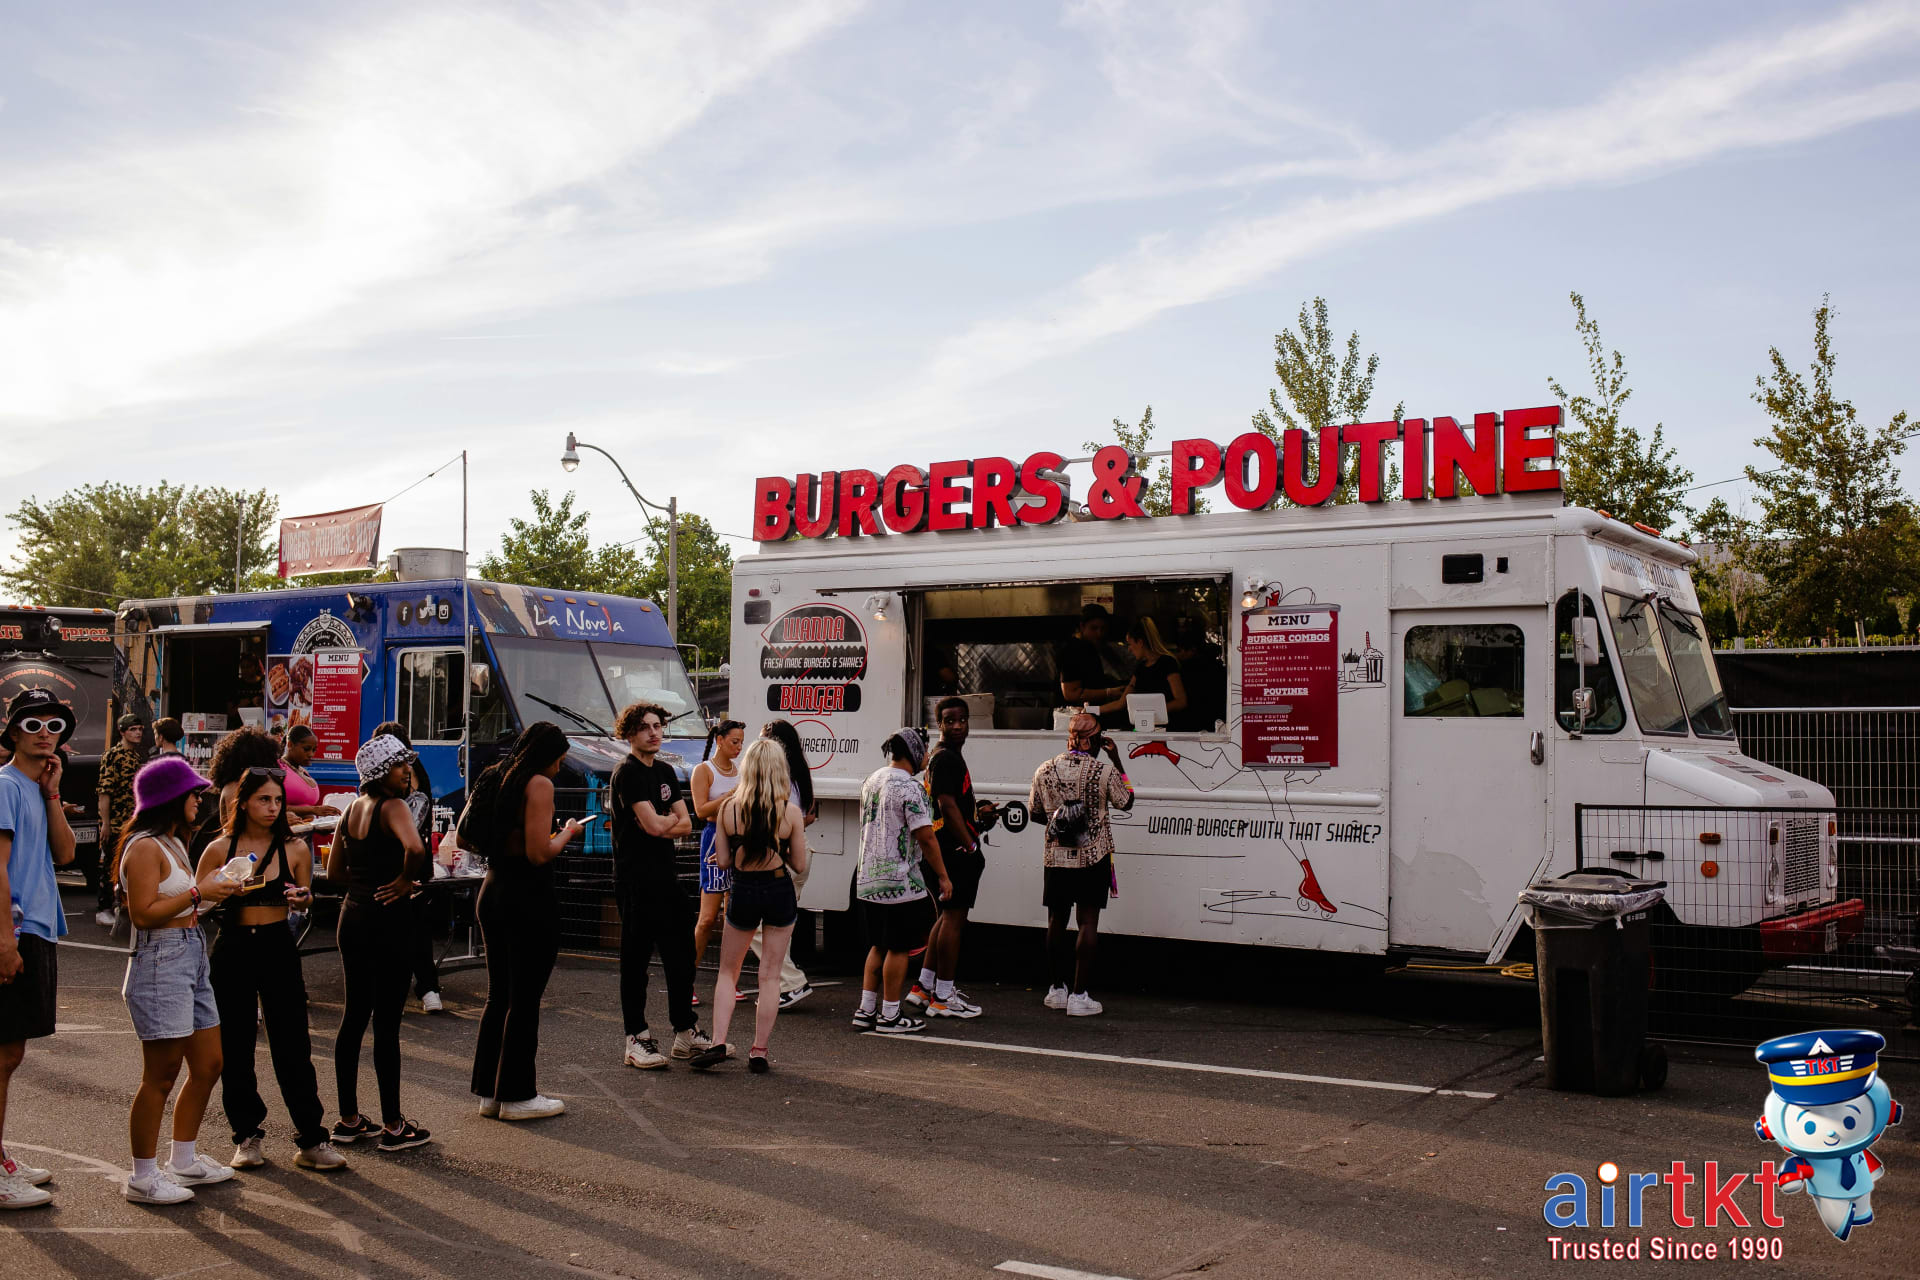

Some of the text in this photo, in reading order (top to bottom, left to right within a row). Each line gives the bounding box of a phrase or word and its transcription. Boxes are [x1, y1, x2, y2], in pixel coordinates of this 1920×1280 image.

[753, 405, 1564, 541] BURGERS & POUTINE
[534, 604, 625, 636] La Novela
[1268, 615, 1310, 626] MENU
[59, 627, 111, 642] TRUCK
[783, 616, 845, 641] WANNA
[1247, 633, 1330, 643] BURGER COMBOS
[328, 654, 349, 662] MENU
[763, 657, 864, 669] FRESH MADE BURGERS & SHAKES
[1263, 688, 1309, 696] POUTINES
[780, 685, 844, 715] BURGER
[1266, 755, 1305, 764] WATER
[1148, 816, 1193, 835] WANNA
[1196, 818, 1245, 838] BURGER
[1249, 820, 1283, 839] WITH
[1289, 822, 1322, 841] THAT
